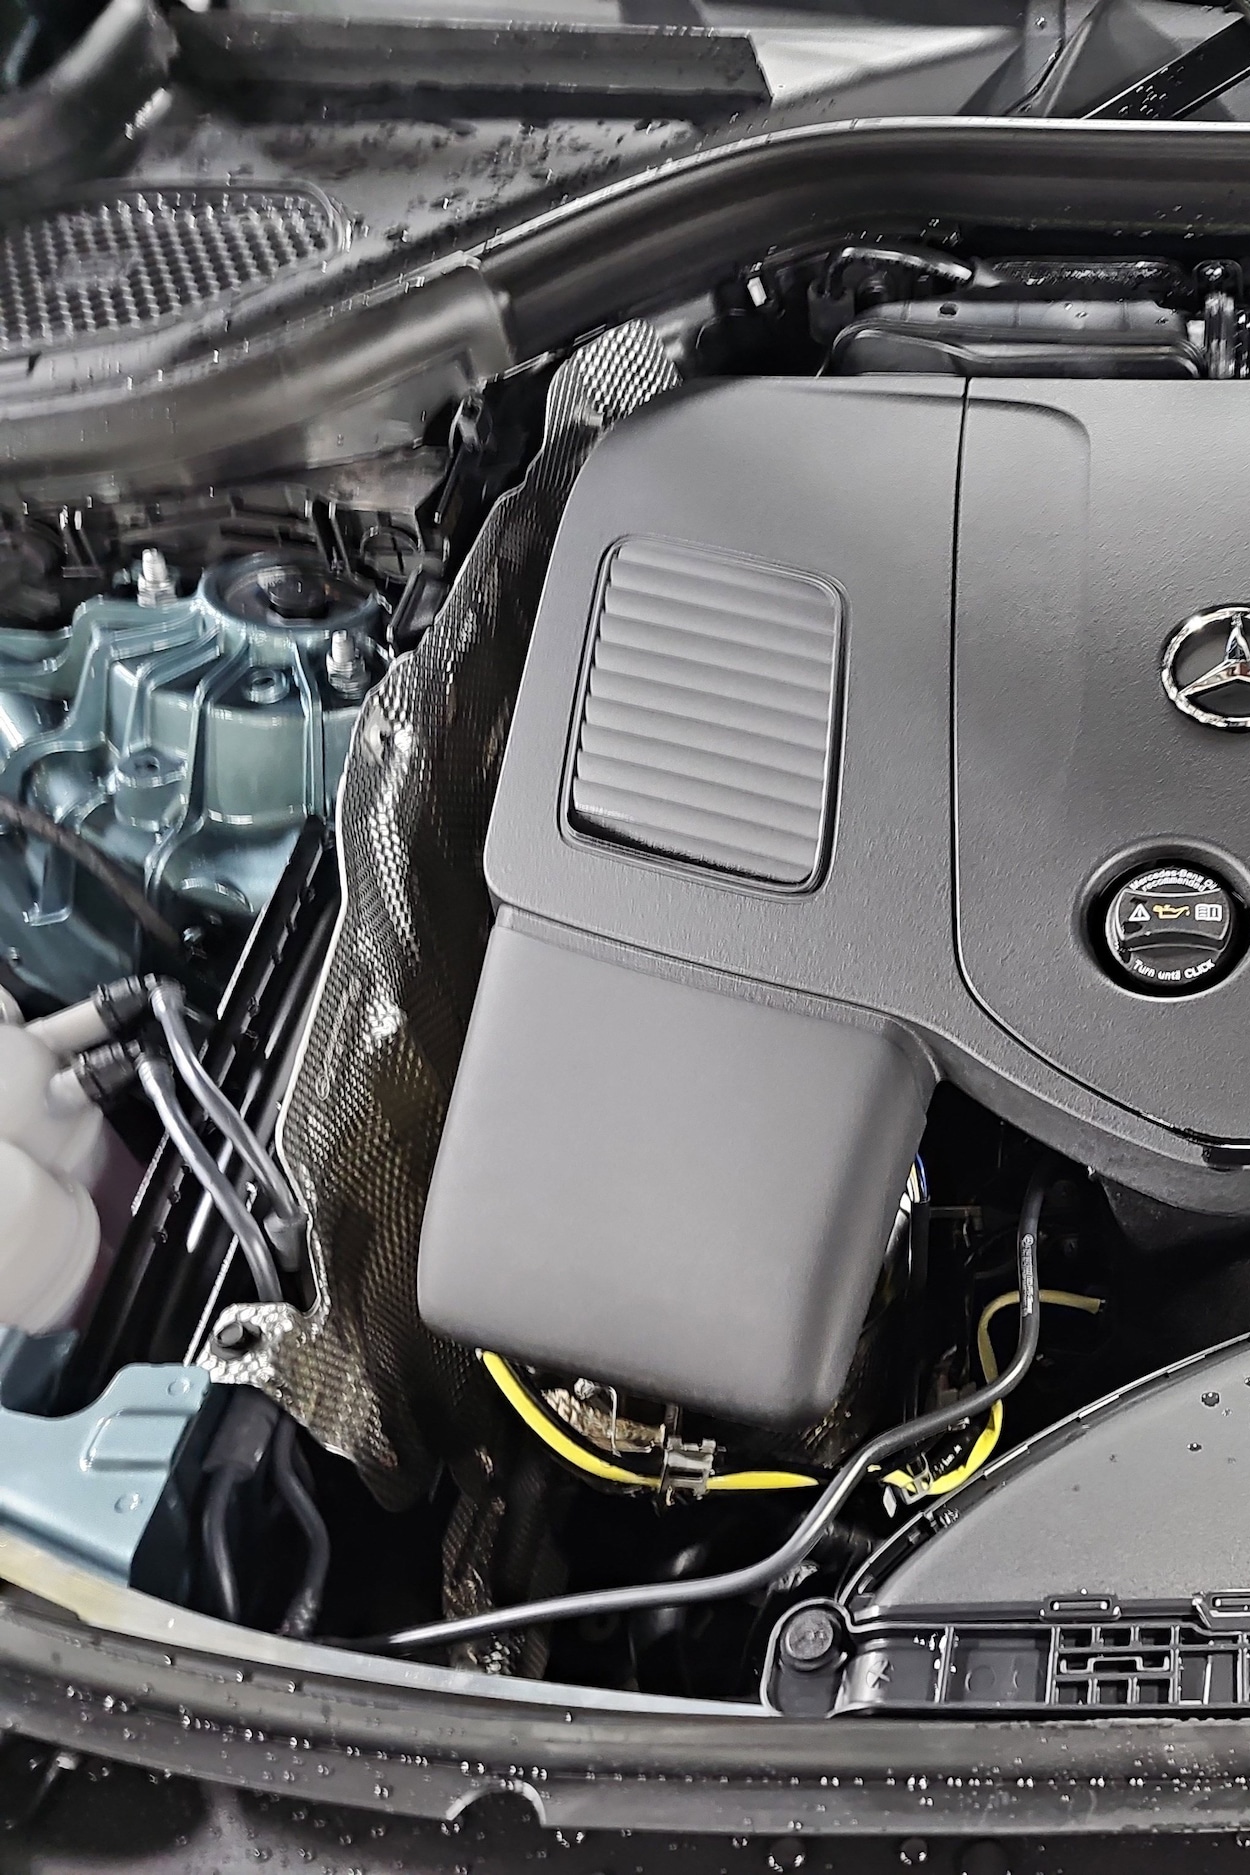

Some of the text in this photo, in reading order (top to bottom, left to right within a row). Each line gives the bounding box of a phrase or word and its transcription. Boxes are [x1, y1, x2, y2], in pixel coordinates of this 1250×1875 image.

[1129, 869, 1204, 890] Mercedes-Benz
[1141, 877, 1206, 892] recommended
[1133, 959, 1215, 980] Turn until CLICK
